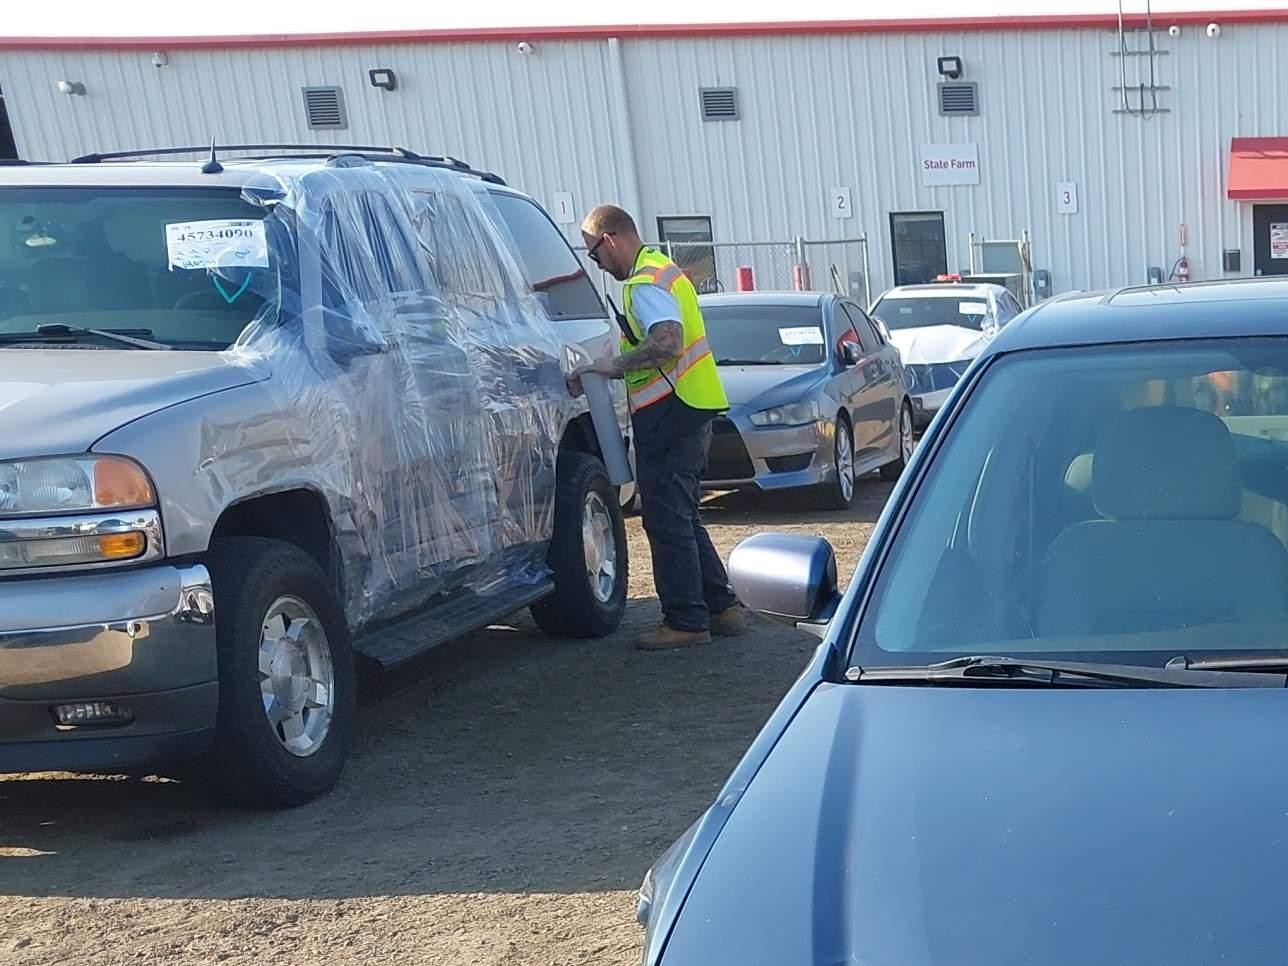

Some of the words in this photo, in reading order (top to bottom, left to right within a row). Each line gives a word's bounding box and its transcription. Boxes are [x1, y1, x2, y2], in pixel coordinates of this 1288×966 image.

[924, 159, 949, 169] State
[951, 158, 976, 169] Farm
[836, 195, 846, 210] 2
[1063, 191, 1071, 205] 3
[176, 227, 253, 242] 45734090
